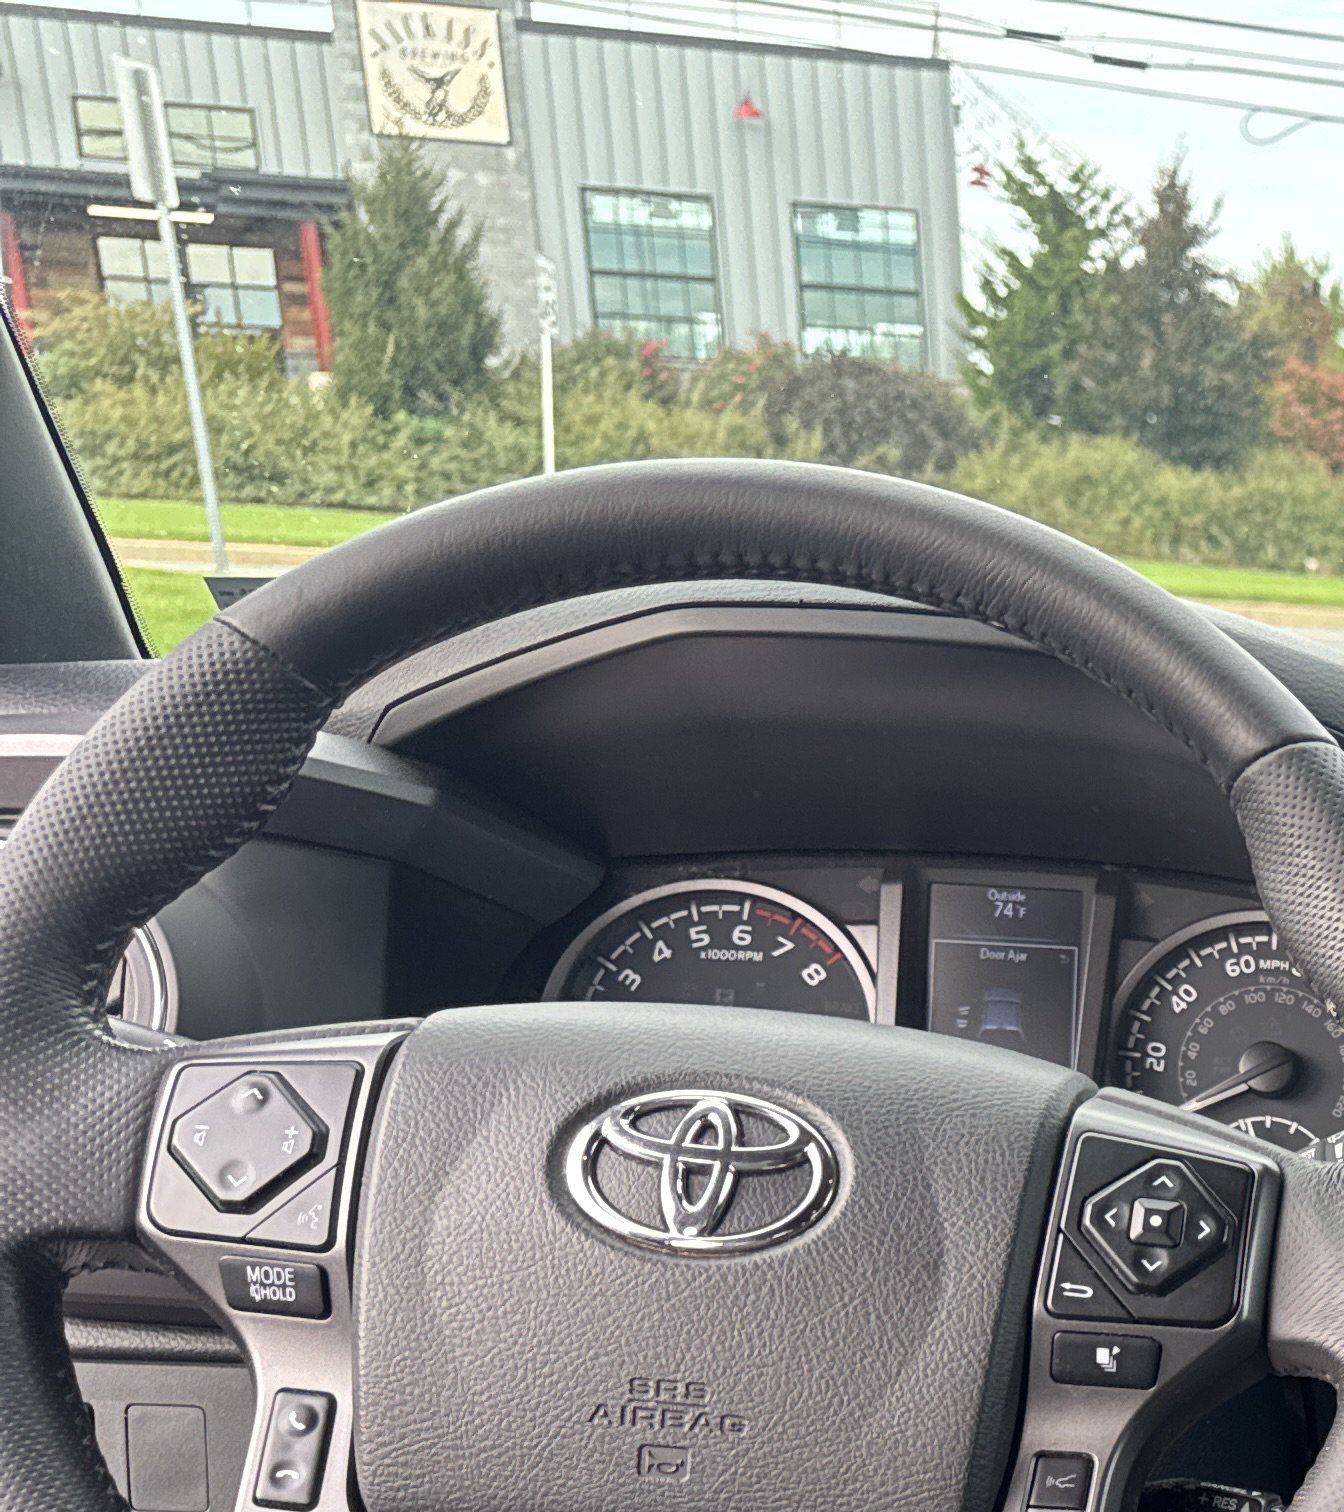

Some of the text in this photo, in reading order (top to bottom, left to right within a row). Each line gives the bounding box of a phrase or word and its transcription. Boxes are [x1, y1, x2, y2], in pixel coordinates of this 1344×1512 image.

[987, 888, 1027, 902] Outside
[689, 925, 711, 949] 5
[732, 925, 752, 946] 6
[652, 940, 672, 963] 4
[771, 936, 796, 958] 7
[980, 948, 1029, 964] Door Ajar
[800, 963, 827, 987] 8
[1225, 955, 1290, 977] 60 MPH
[617, 968, 642, 991] 3
[1259, 974, 1290, 985] km/h
[1170, 984, 1198, 1014] 40
[1218, 999, 1237, 1016] 80
[1244, 992, 1266, 1005] 100
[1274, 993, 1296, 1006] 120
[1301, 1000, 1322, 1019] 140
[1198, 1017, 1214, 1035] 60
[1145, 1042, 1167, 1072] 20
[1188, 1042, 1201, 1060] 40
[1186, 1070, 1198, 1087] 20
[246, 1265, 296, 1286] MODE
[261, 1286, 296, 1302] HOLD
[629, 1376, 708, 1400] SRS
[587, 1403, 750, 1438] AIRBAG
[1212, 1495, 1238, 1511] RES
